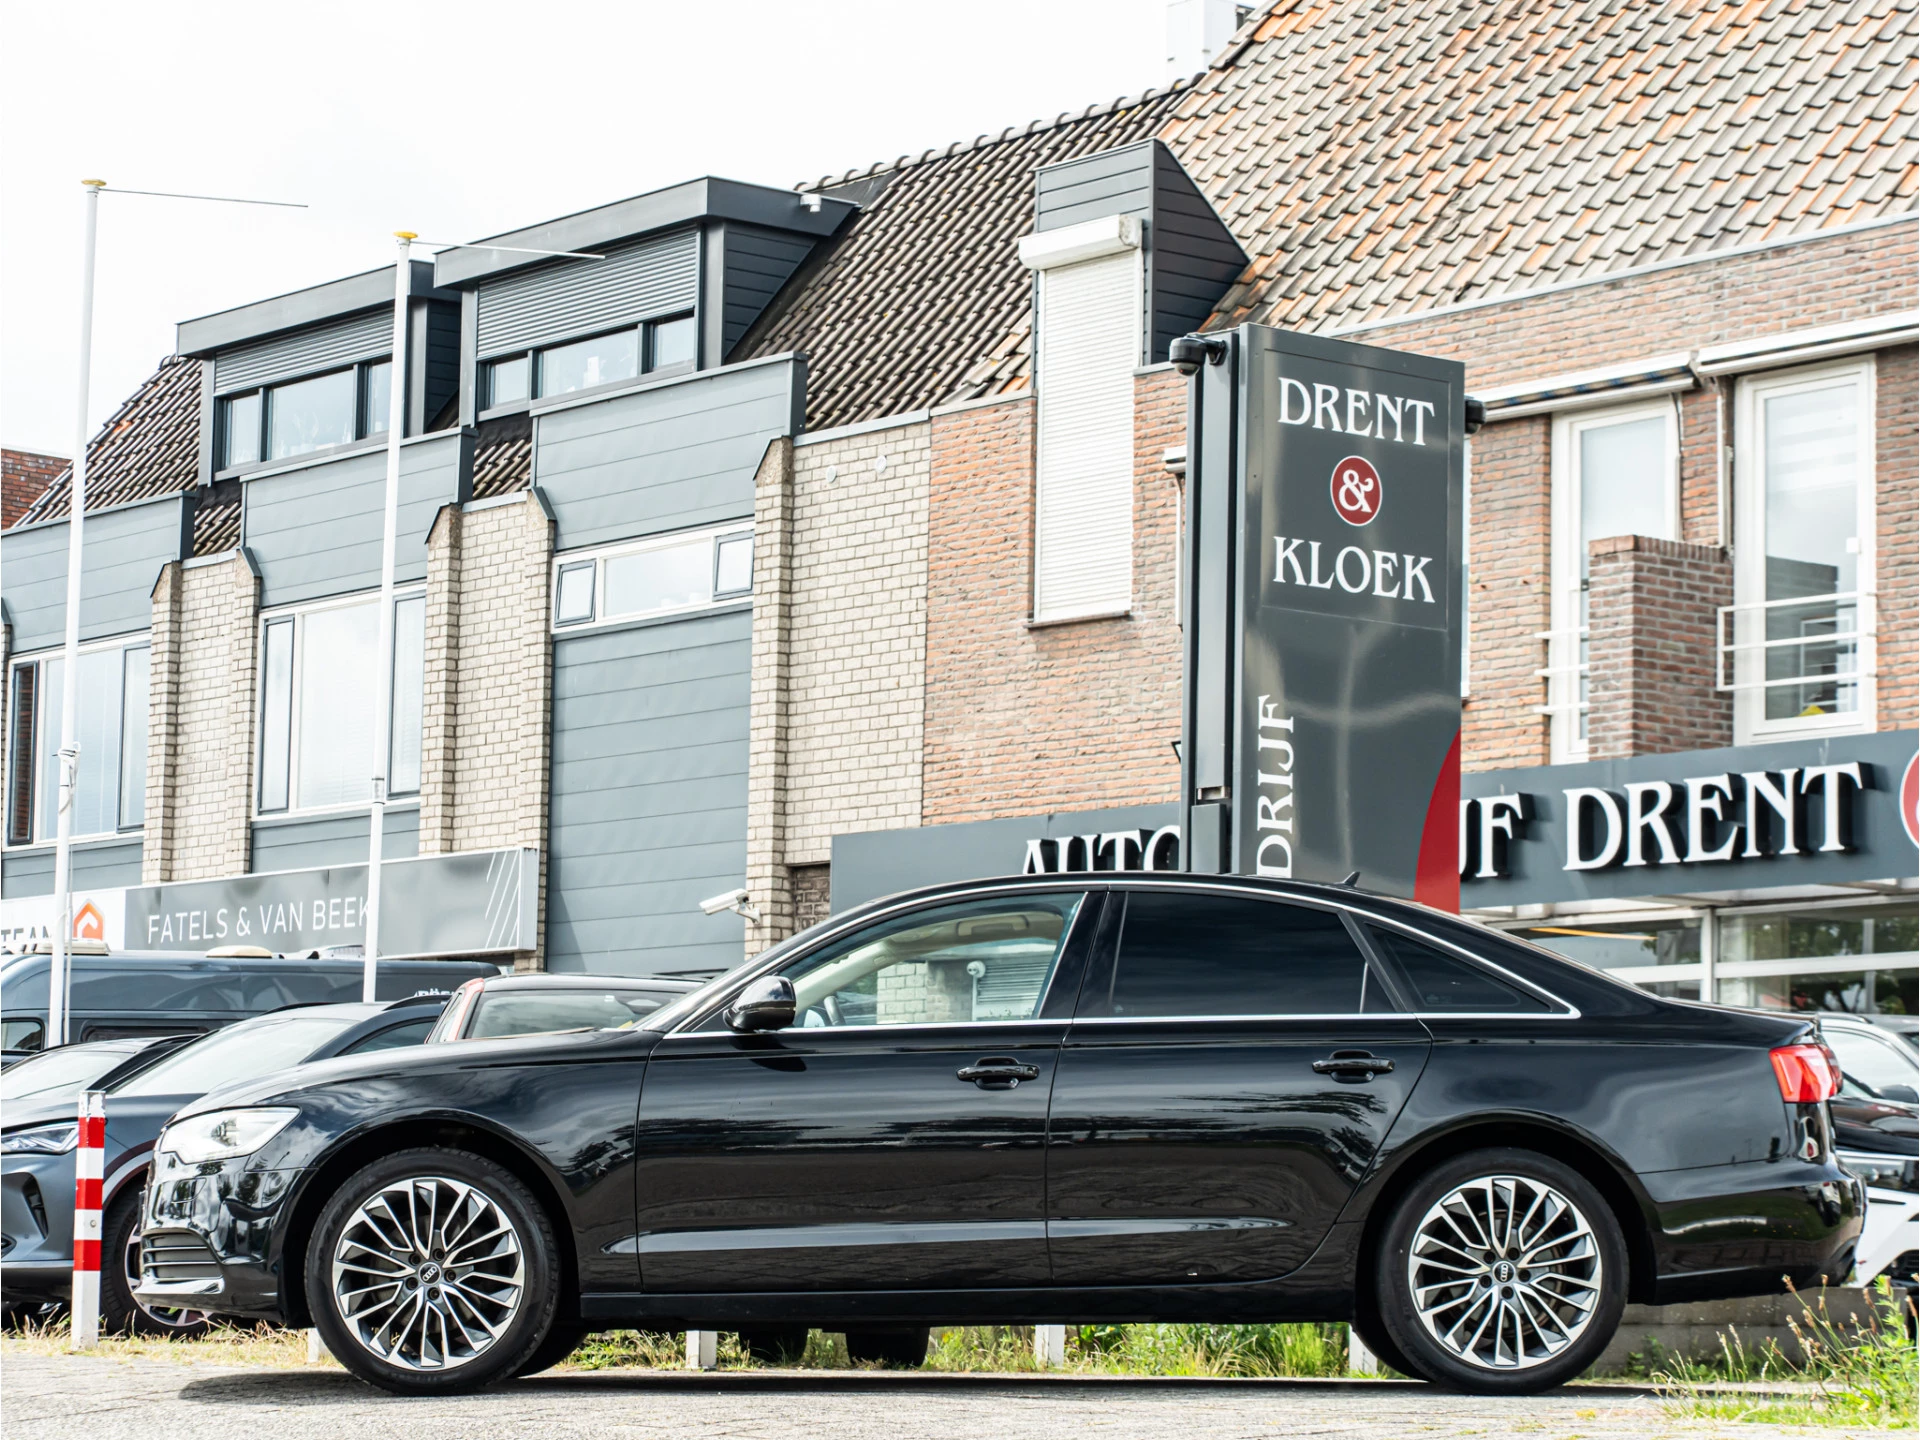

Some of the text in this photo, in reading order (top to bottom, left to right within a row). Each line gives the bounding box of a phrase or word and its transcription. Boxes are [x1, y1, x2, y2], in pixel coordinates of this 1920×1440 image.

[1278, 377, 1435, 446] DRENT
[1338, 469, 1374, 513] &
[1273, 536, 1435, 603] KLOEK
[1562, 761, 1863, 871] DRENT
[148, 896, 369, 944] FATELS & VAN BEEK
